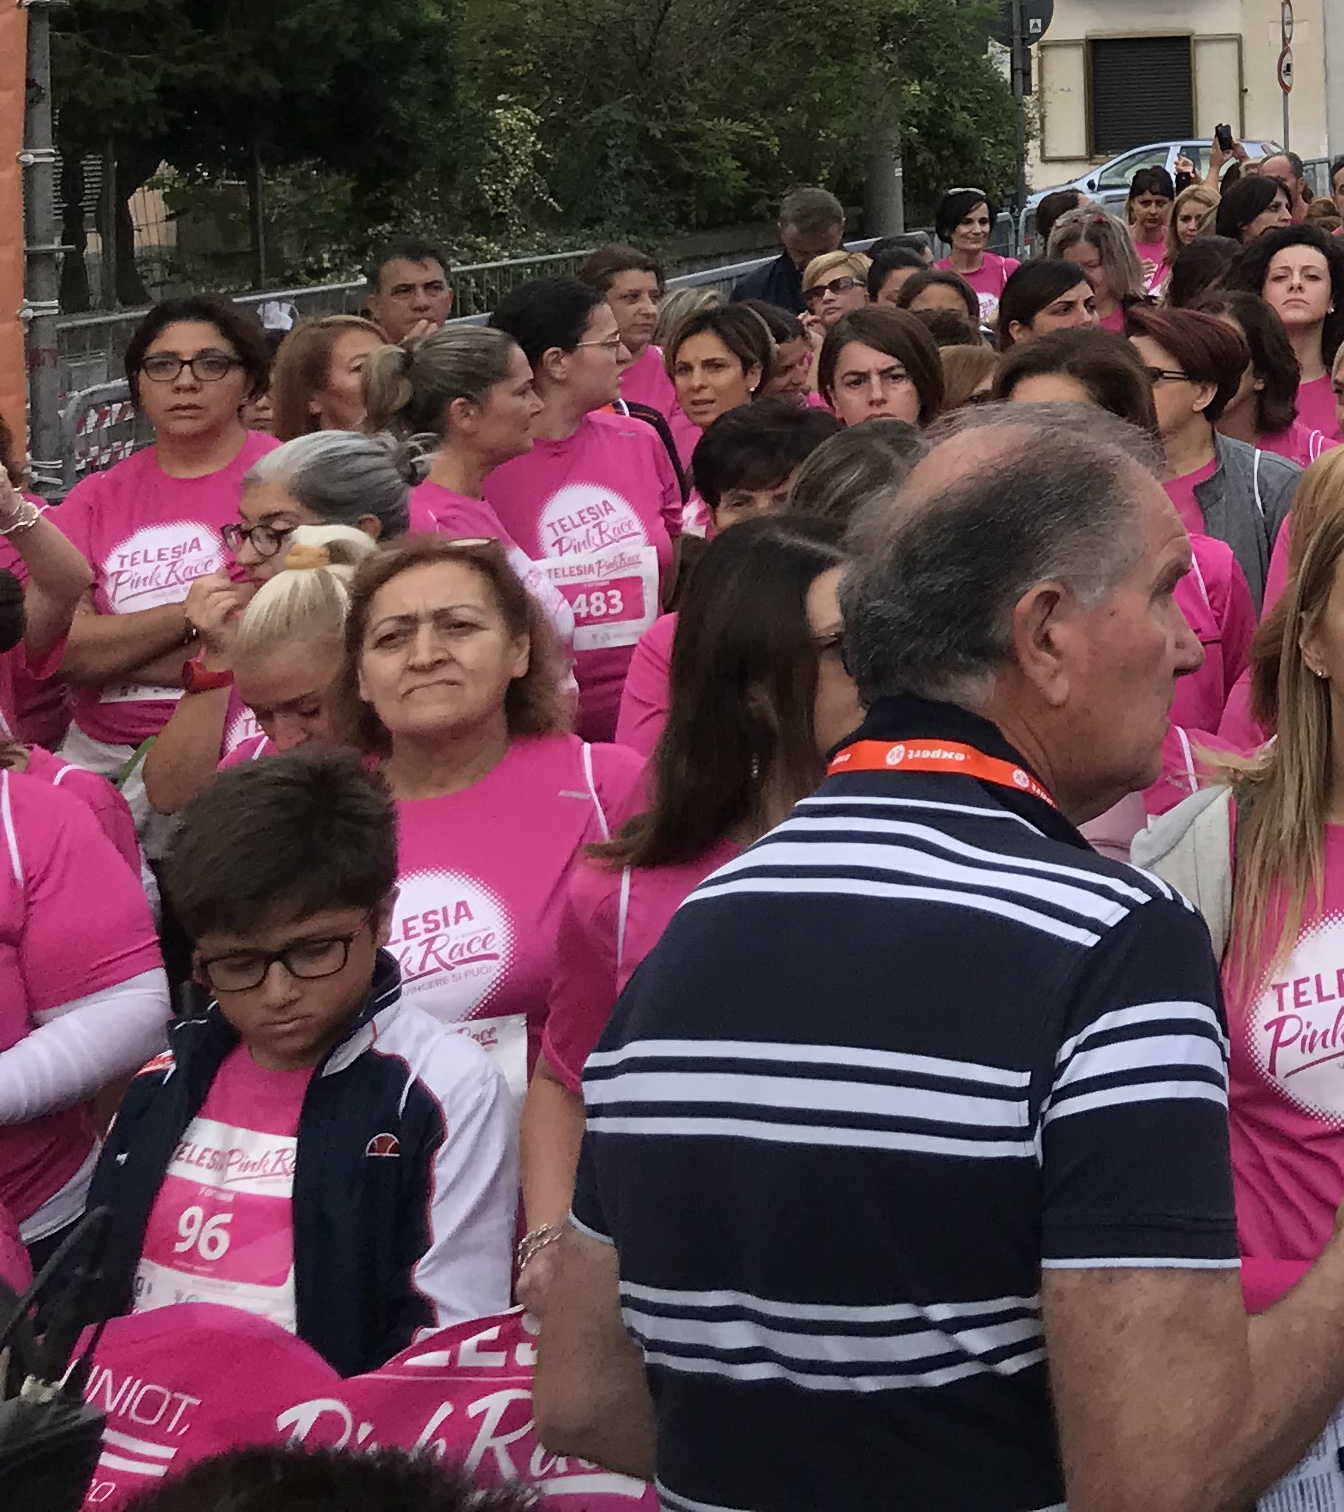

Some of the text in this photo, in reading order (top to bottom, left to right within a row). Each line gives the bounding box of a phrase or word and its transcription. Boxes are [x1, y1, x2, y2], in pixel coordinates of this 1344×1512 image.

[546, 500, 617, 537] TELESIA
[116, 536, 203, 569] TELESIA
[551, 519, 636, 557] Pink Race
[109, 558, 215, 603] Pink Race
[546, 561, 596, 580] TELESIA
[572, 589, 624, 619] 483
[908, 748, 966, 762] expert
[418, 932, 497, 973] Race
[226, 1147, 270, 1176] Pink
[172, 1205, 235, 1262] 96
